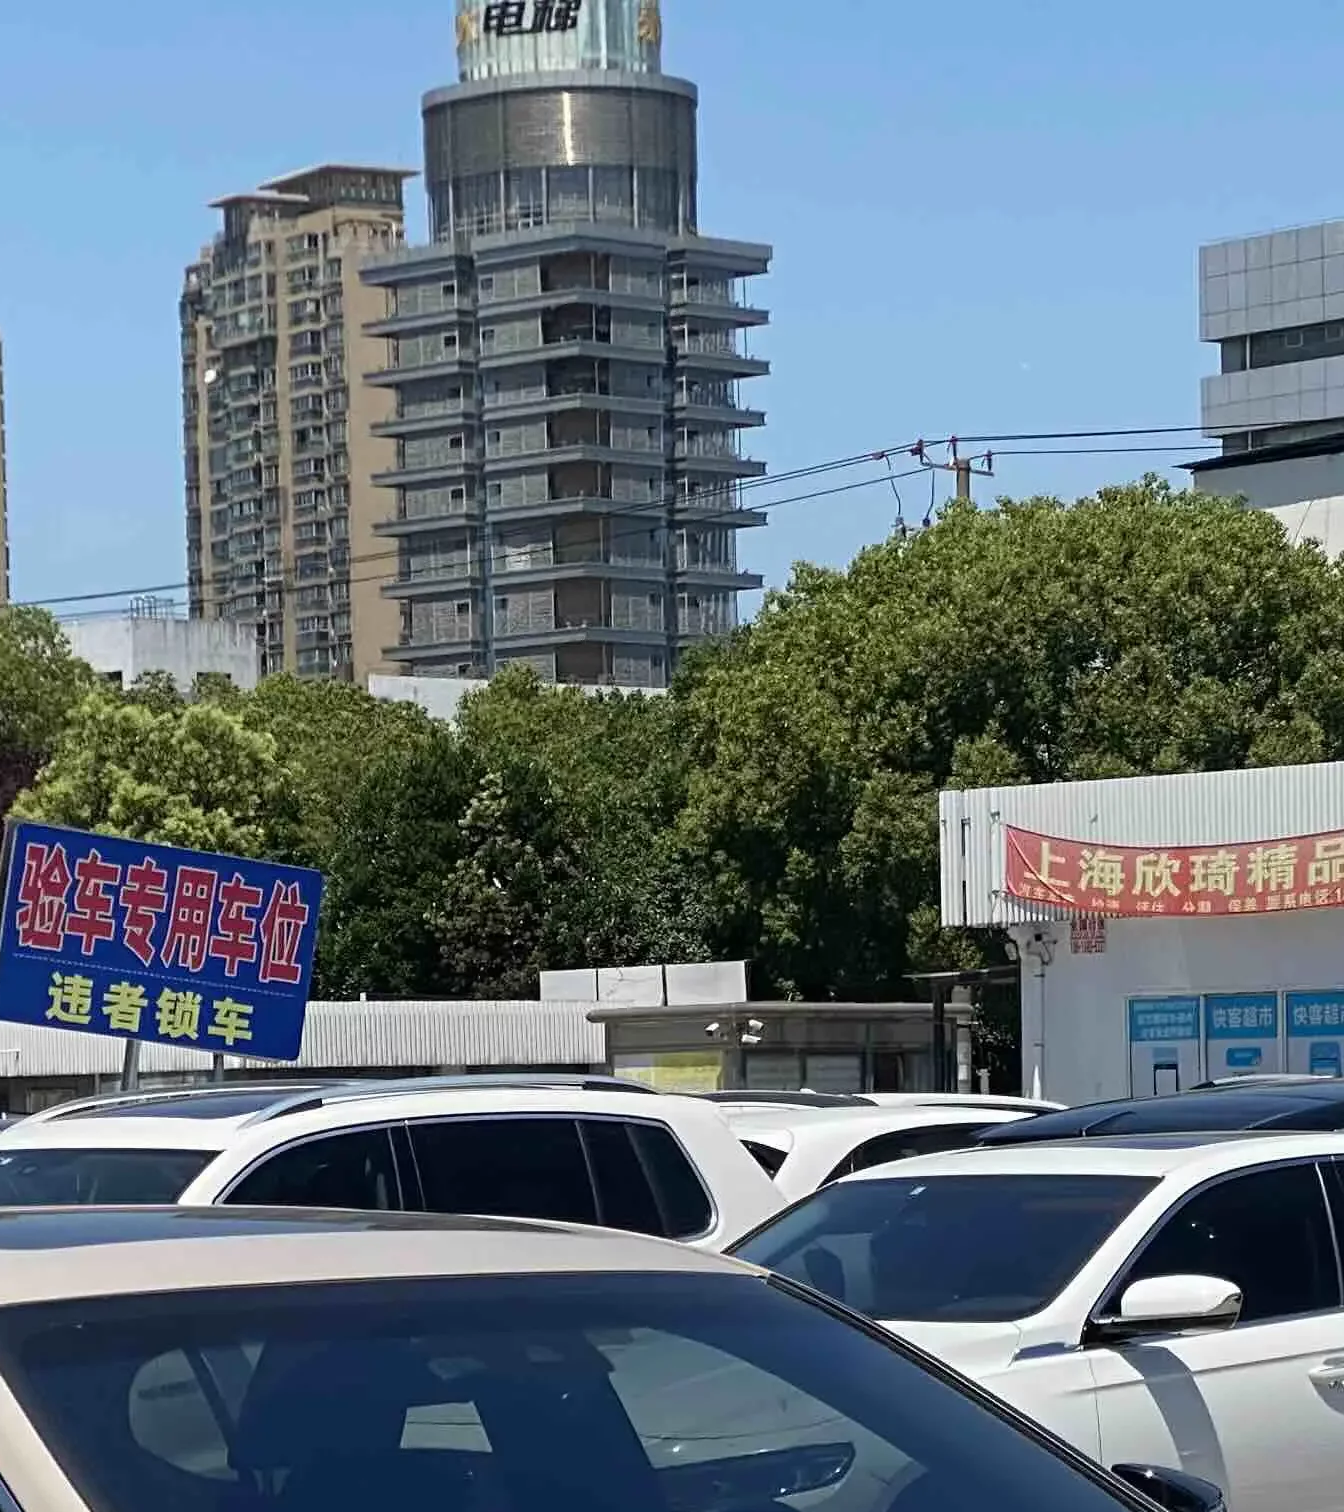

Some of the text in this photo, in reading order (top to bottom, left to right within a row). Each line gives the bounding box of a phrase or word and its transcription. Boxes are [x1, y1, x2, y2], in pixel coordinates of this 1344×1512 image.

[483, 0, 581, 37] 电梯
[17, 842, 309, 984] 验车专用车位
[46, 971, 253, 1046] 违者锁车
